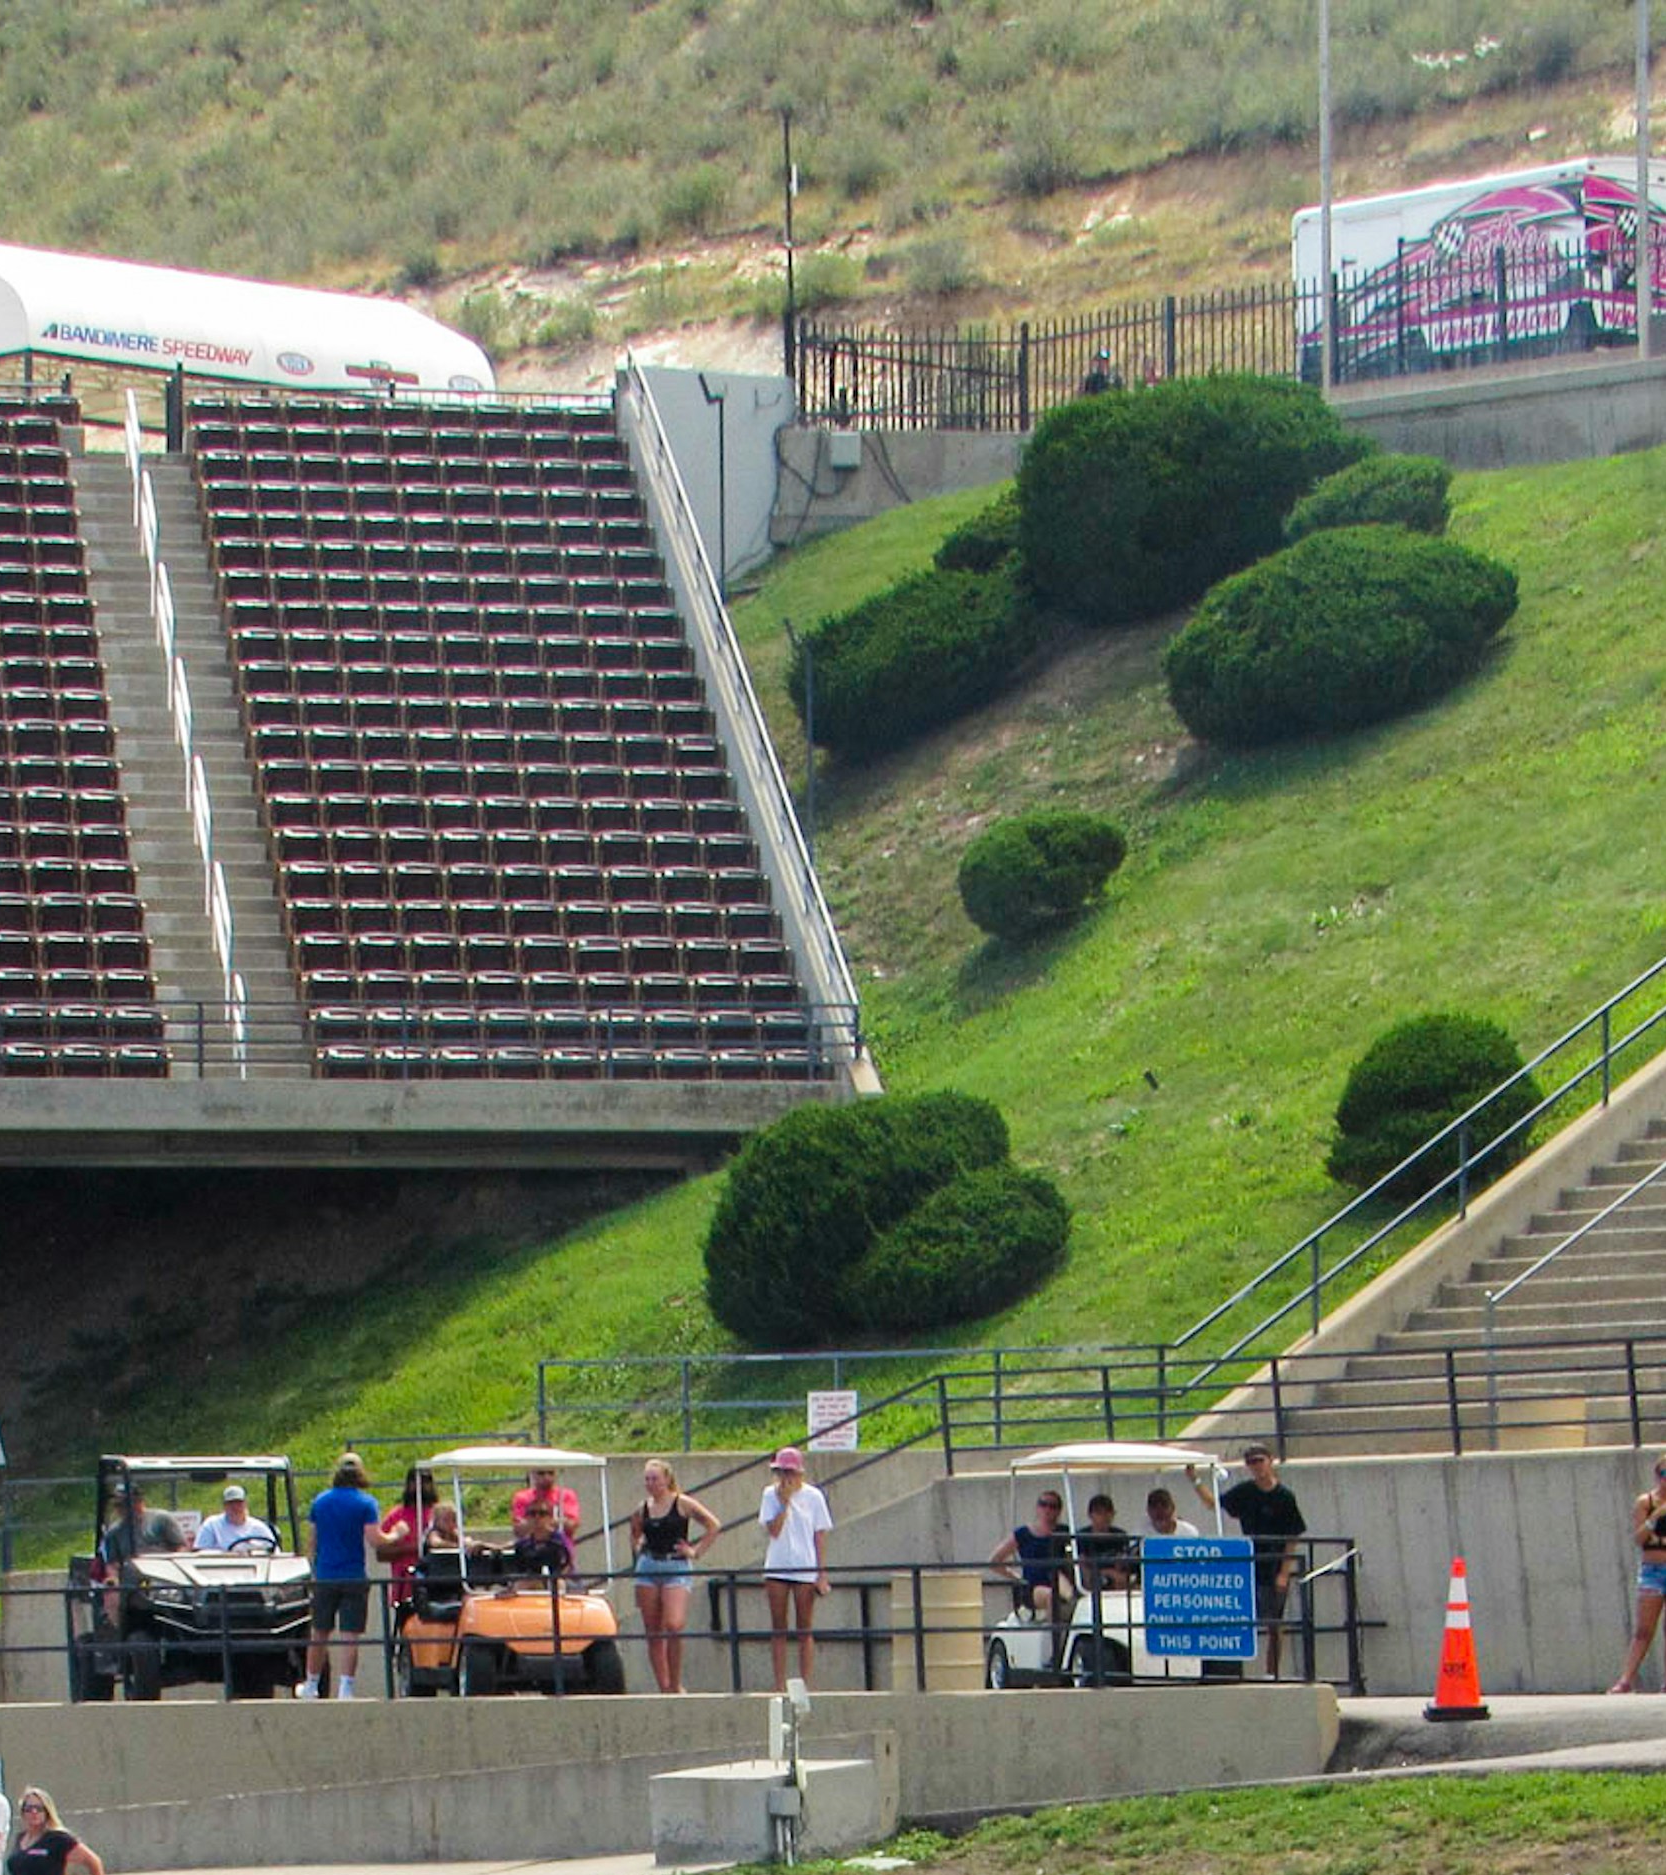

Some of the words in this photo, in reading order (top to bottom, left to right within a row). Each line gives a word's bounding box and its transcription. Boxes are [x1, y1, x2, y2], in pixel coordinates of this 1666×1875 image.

[60, 324, 159, 354] BANDIMERE
[162, 337, 253, 367] SPEEDWAY
[1152, 1573, 1244, 1589] AUTHORIZED
[1154, 1594, 1242, 1610] PERSONNEL
[1159, 1634, 1192, 1649] THIS
[1199, 1634, 1242, 1649] POINT
